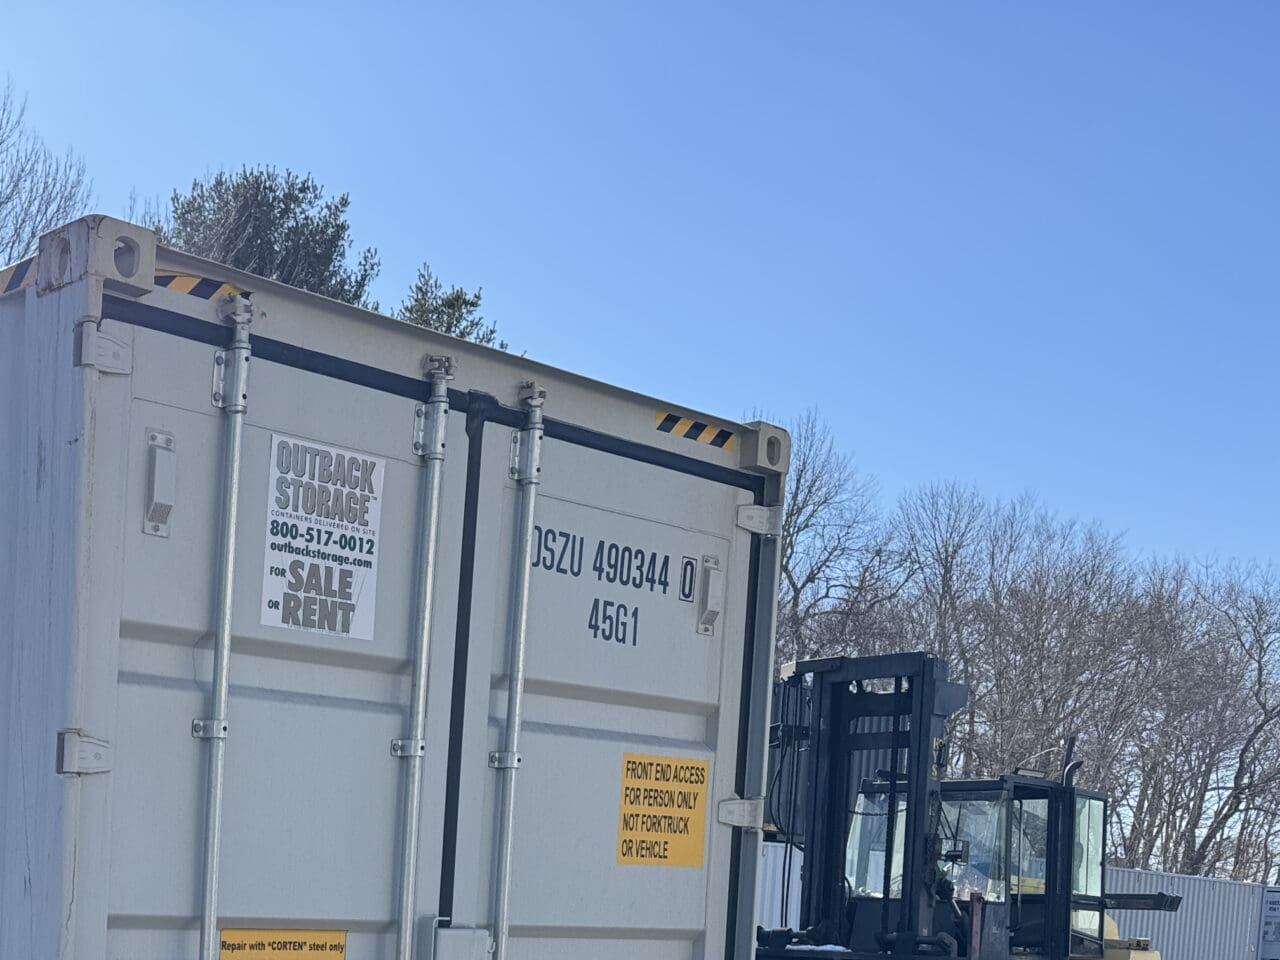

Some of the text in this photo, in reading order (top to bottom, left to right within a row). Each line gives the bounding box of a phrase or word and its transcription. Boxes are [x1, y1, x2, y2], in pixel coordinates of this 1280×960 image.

[276, 440, 376, 494] OUTBACK
[275, 475, 370, 527] STORAGE
[270, 519, 375, 555] 800-517-0012
[271, 509, 376, 537] CONTAINERS DELIVERED ON SITE
[270, 541, 373, 569] outbackstorage.com
[592, 540, 671, 595] 490344
[681, 559, 695, 599] 0
[270, 559, 353, 601] FOR SALE
[267, 599, 280, 610] OR
[281, 592, 355, 633] RENT
[588, 598, 639, 647] 45G1
[625, 760, 706, 785] FRONT END ACCESS
[624, 786, 699, 810] FOR PERSON ONLY
[622, 813, 690, 835] NOT FORKTRUCK
[621, 839, 669, 859] OR VEHICLE
[221, 941, 246, 953] Repair
[248, 940, 266, 951] with
[308, 941, 327, 951] steel
[328, 942, 345, 954] only
